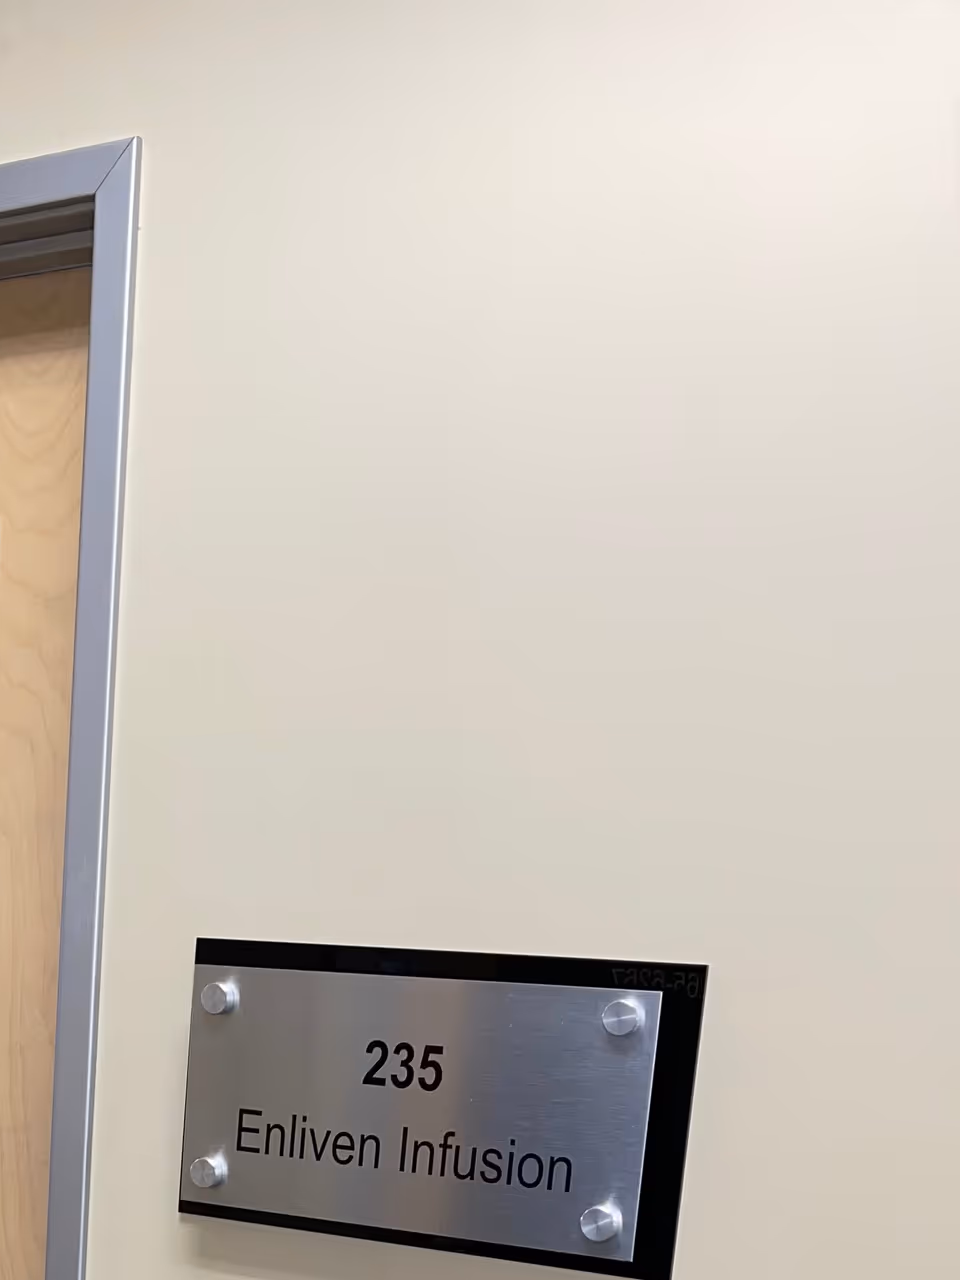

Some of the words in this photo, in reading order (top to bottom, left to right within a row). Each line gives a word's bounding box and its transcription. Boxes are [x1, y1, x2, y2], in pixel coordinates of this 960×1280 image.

[361, 1039, 445, 1092] 235
[235, 1107, 381, 1169] Enliven
[398, 1126, 574, 1193] Infusion
